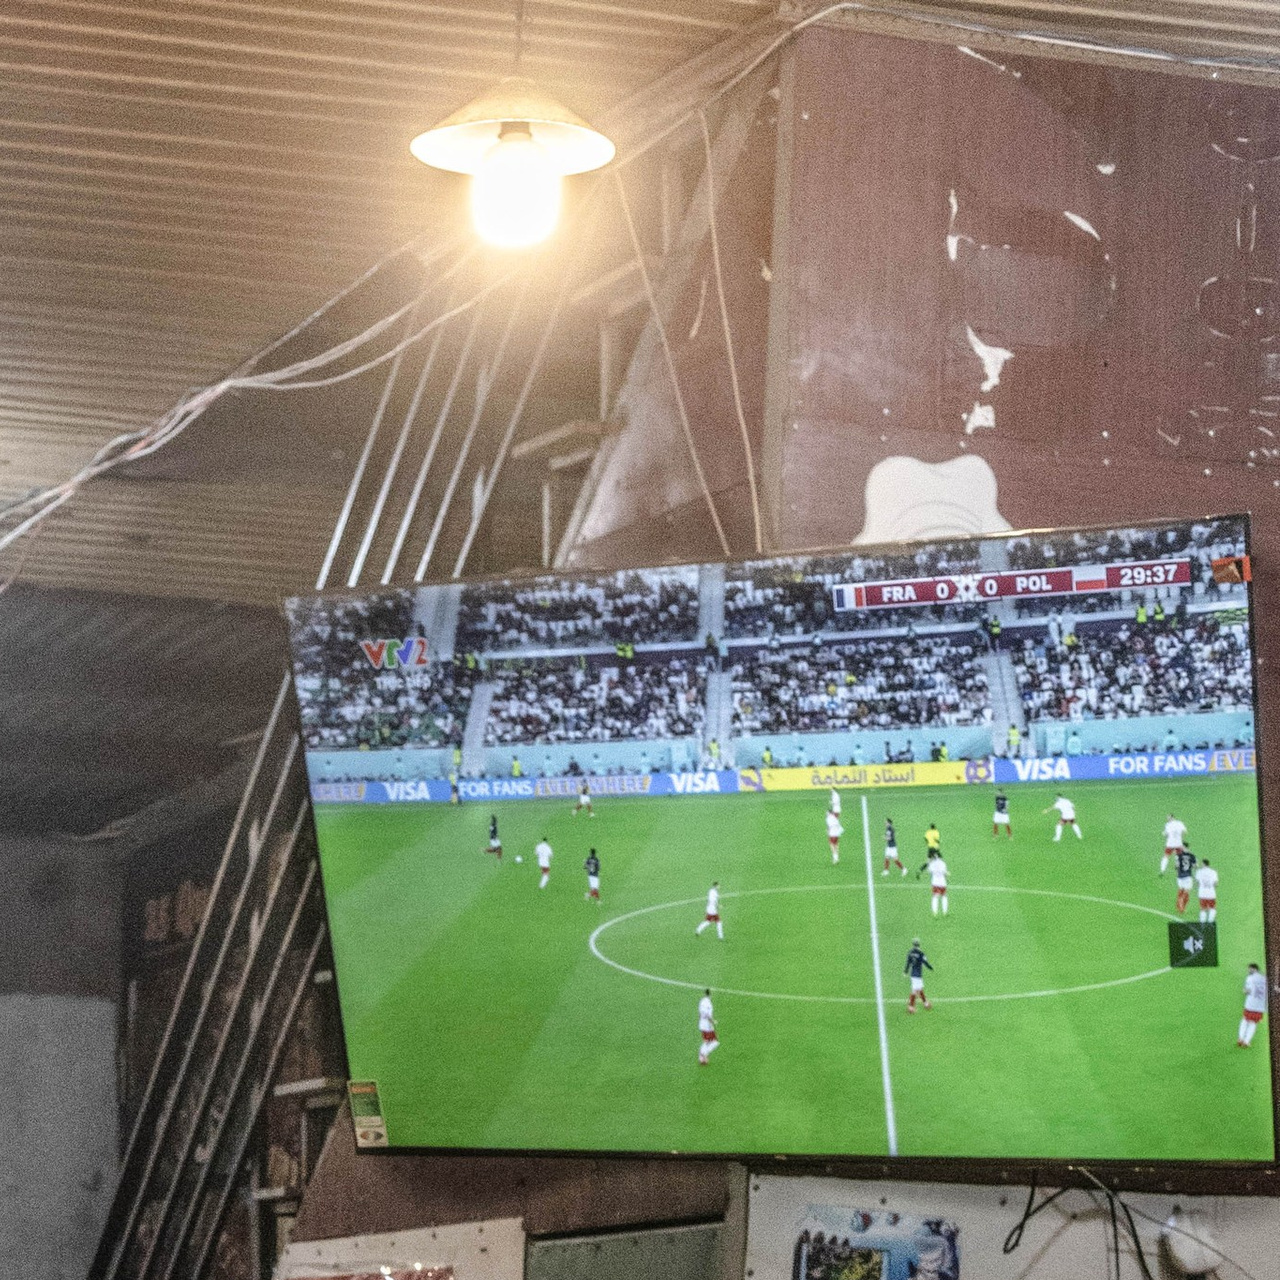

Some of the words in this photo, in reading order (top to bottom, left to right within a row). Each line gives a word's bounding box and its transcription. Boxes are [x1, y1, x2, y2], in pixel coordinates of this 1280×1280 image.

[1120, 563, 1178, 586] 29:37
[881, 585, 918, 604] FRA
[935, 582, 950, 601] 0
[983, 577, 998, 596] 0
[1015, 575, 1053, 594] POL
[1014, 757, 1072, 781] VISA
[1109, 756, 1149, 775] FOR
[1154, 753, 1207, 773] FANS
[385, 781, 431, 801] VISA
[459, 779, 489, 798] FOR
[492, 778, 534, 798] FANS
[669, 772, 720, 794] VISA
